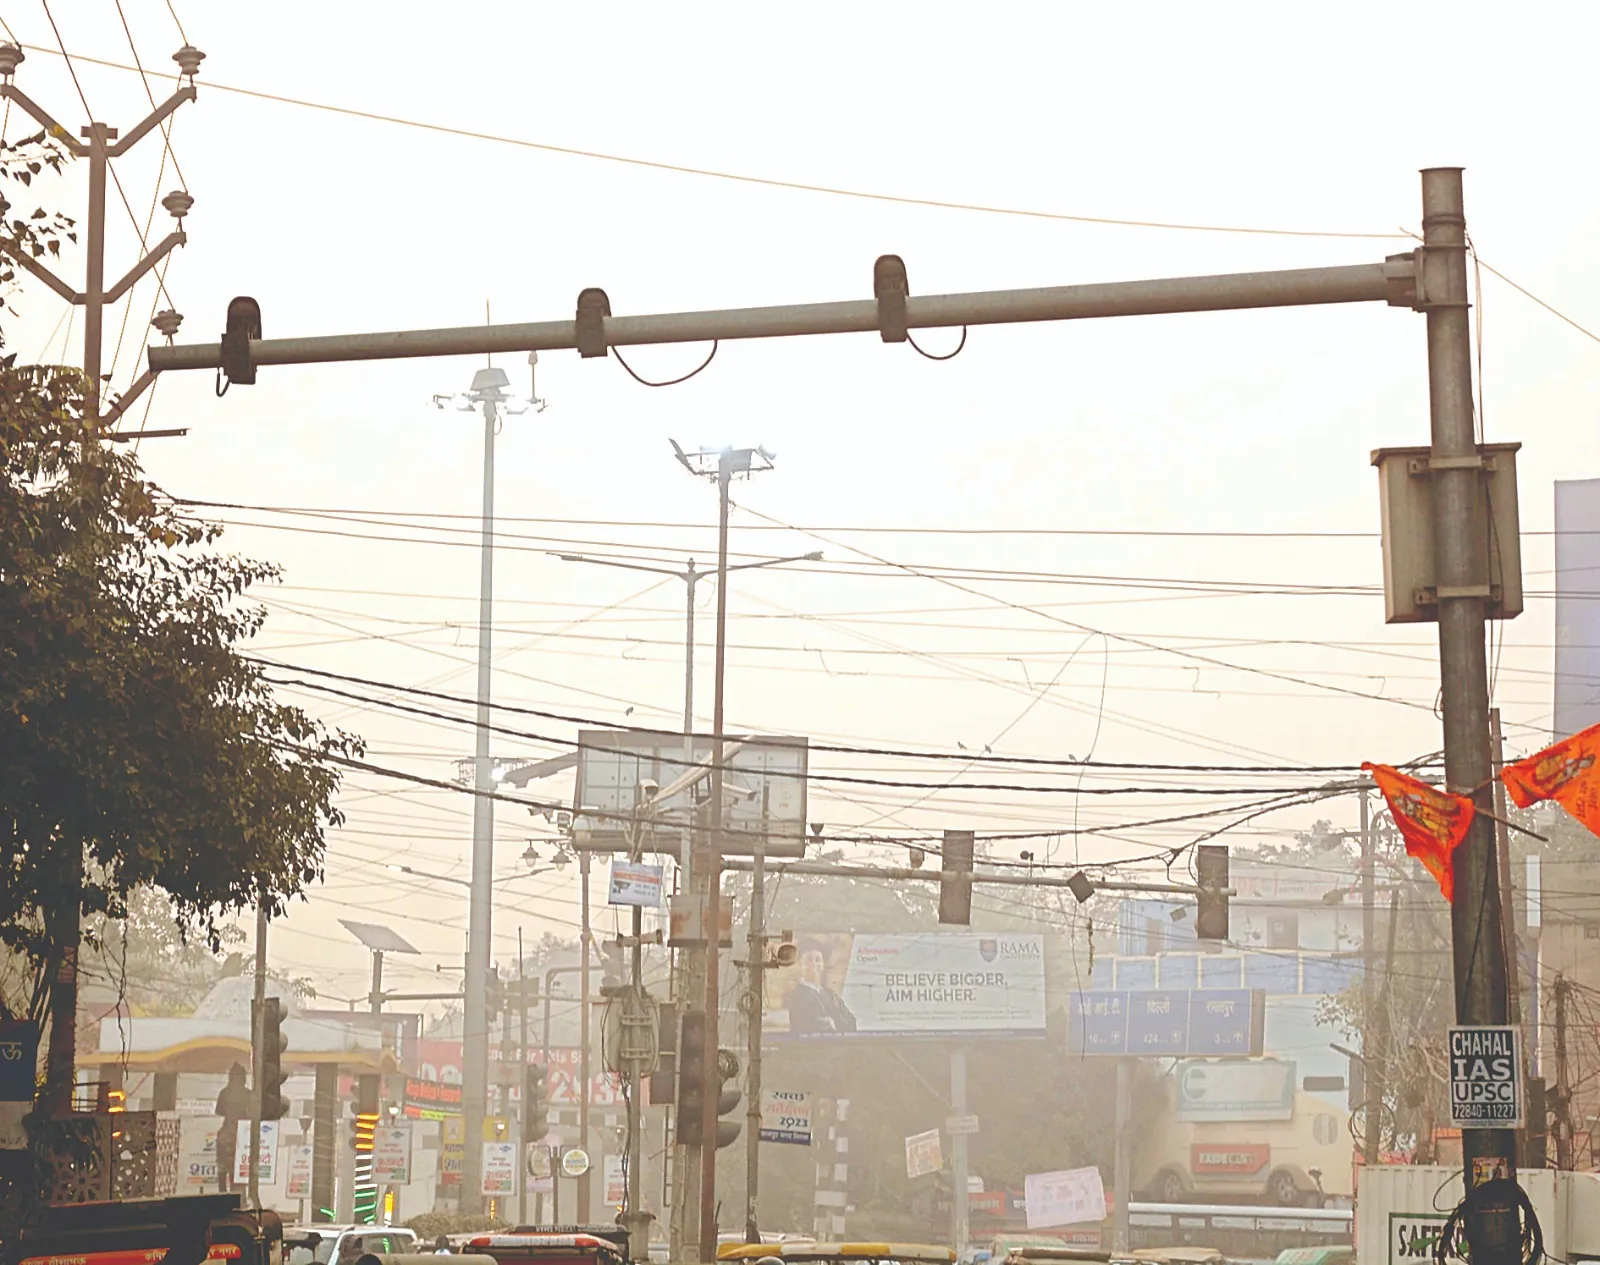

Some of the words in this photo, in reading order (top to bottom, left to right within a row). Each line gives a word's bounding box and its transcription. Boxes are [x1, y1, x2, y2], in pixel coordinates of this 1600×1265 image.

[1000, 942, 1040, 954] RAMA
[856, 955, 877, 963] Open
[885, 973, 945, 987] BELIEVE
[885, 988, 912, 1002] AIM
[917, 988, 977, 1002] HIGHER.
[1452, 1032, 1511, 1056] CHAHAL
[1453, 1058, 1511, 1081] IAS
[1455, 1082, 1511, 1102] UPSC
[1454, 1104, 1514, 1118] 72840-11227
[780, 1116, 808, 1128] 2023
